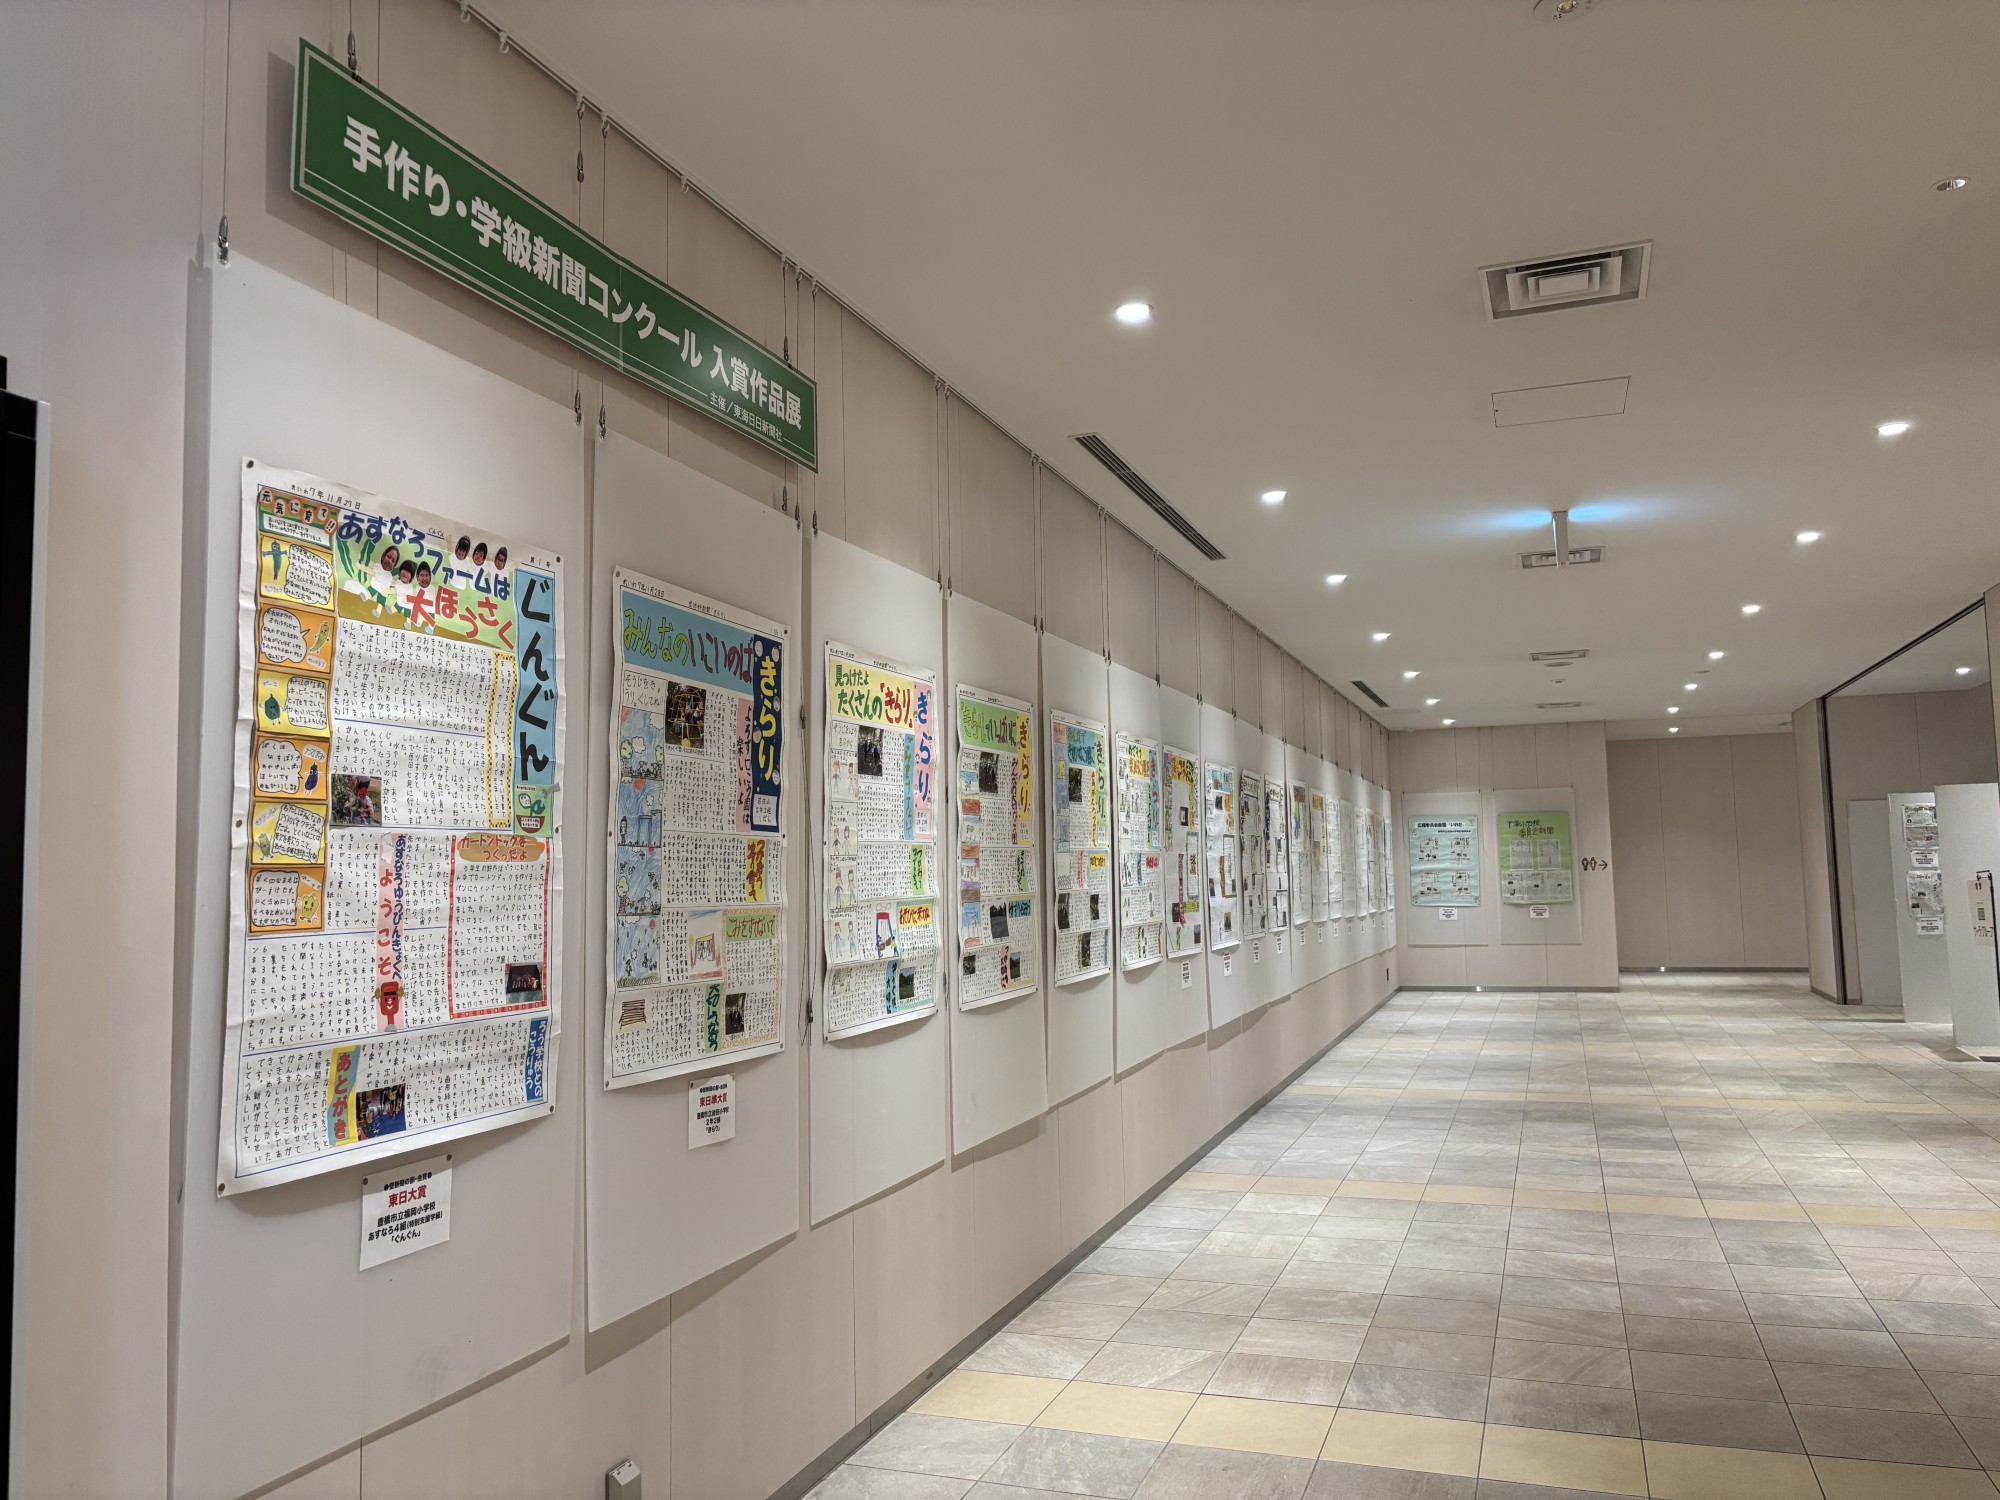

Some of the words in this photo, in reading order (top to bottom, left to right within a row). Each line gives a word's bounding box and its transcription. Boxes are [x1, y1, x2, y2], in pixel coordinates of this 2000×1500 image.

[343, 115, 702, 368] 手作り・学級新聞コンクール
[710, 350, 802, 430] 入賞作品展
[709, 390, 783, 442] 主催／東海日日新聞社
[406, 584, 515, 651] 大ほうさく
[623, 608, 755, 684] みんなのいこいのば
[835, 664, 869, 687] 見つけたよ
[758, 655, 778, 781] きらり
[917, 692, 931, 802] きらり
[377, 868, 394, 976] ようこそ
[526, 1031, 537, 1090] こうりゅう
[534, 1020, 547, 1097] ろう学校との
[332, 1052, 352, 1140] あとがき
[699, 1092, 728, 1108] 東日準大賞
[376, 1200, 436, 1228] 豊橋市立福岡小学校
[388, 1184, 427, 1209] 東日大賞
[391, 1229, 421, 1244] 「ぐんぐん」
